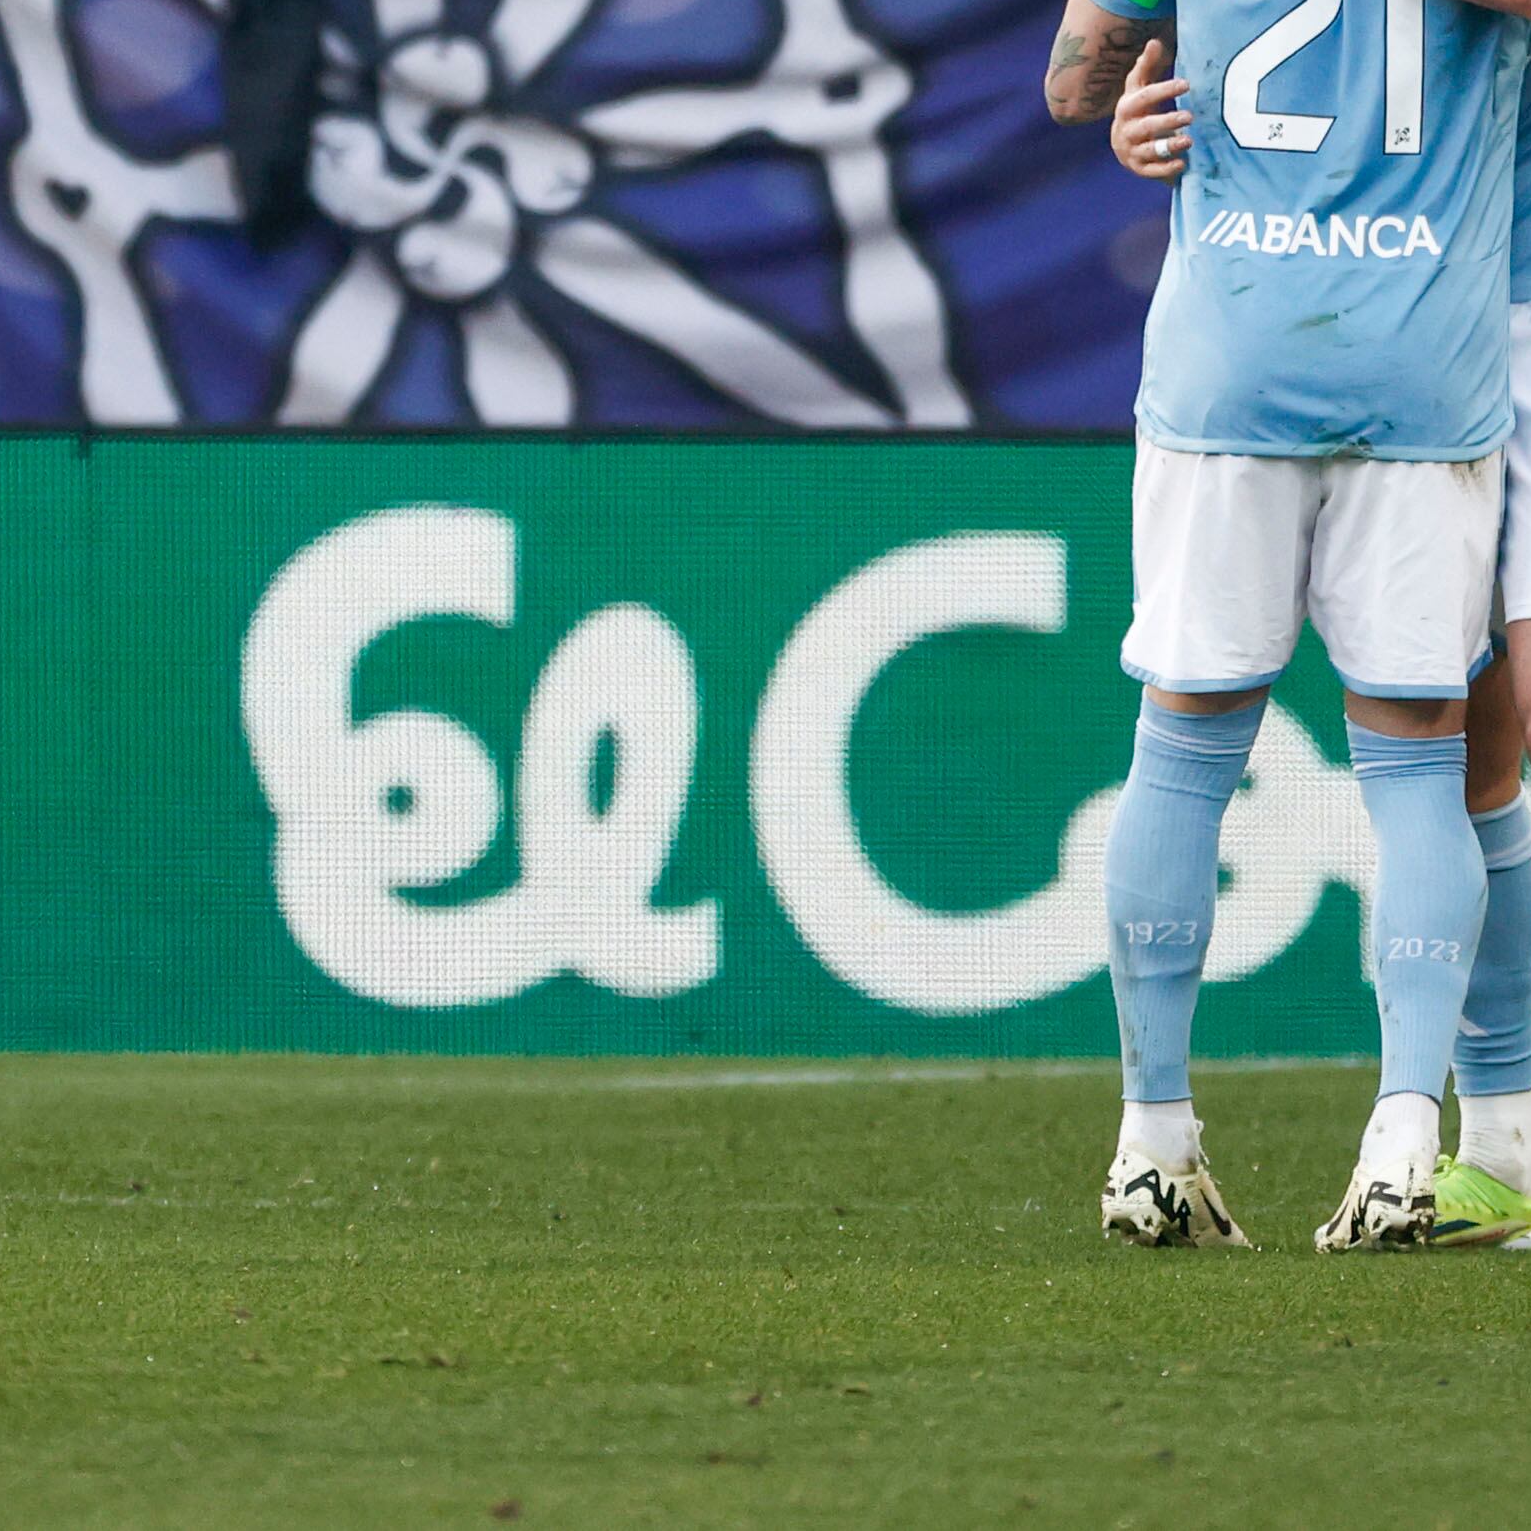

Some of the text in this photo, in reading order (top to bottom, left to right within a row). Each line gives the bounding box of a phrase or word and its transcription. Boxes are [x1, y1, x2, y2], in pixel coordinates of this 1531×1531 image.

[240, 501, 722, 1009] El
[1124, 921, 1199, 946] 1923
[1387, 936, 1462, 963] 2023
